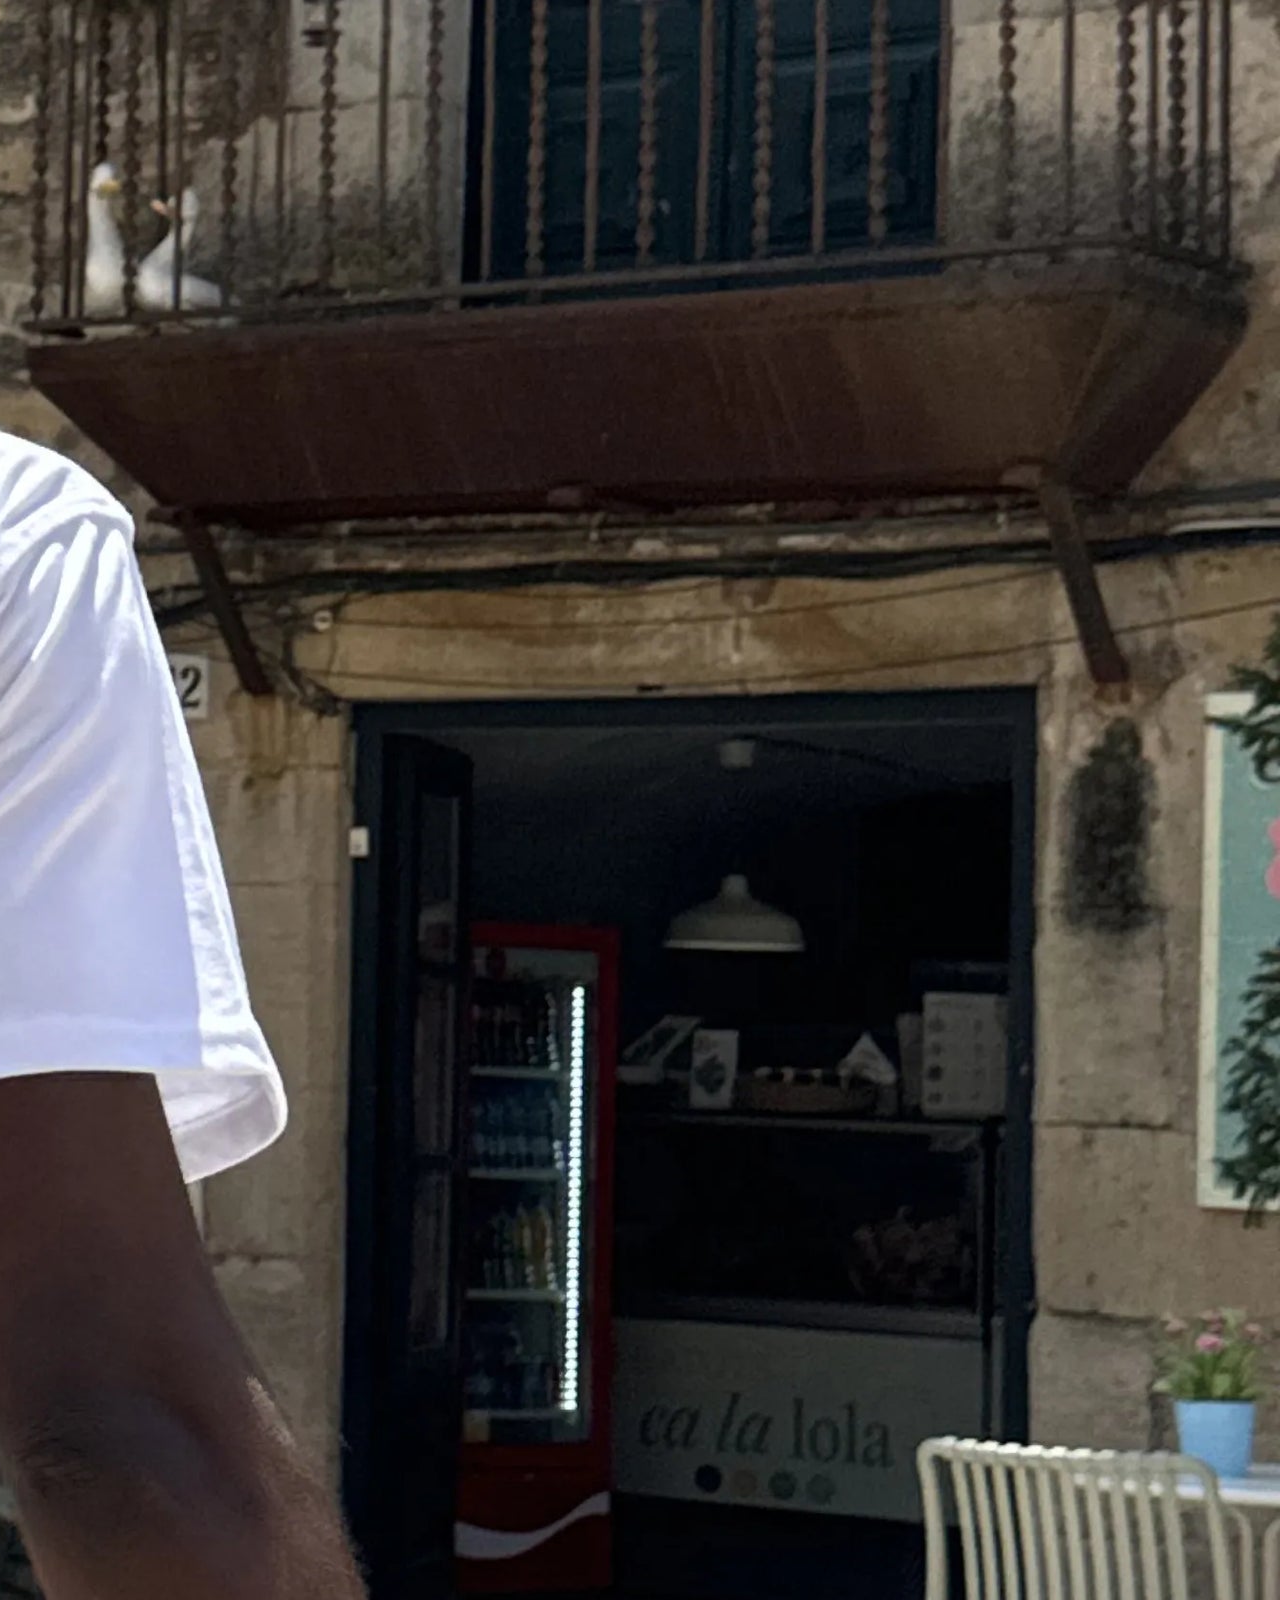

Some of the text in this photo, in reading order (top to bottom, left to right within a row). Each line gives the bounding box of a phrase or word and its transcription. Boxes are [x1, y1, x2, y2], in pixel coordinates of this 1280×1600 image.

[170, 665, 201, 708] 2
[639, 1391, 896, 1469] ca la lola
